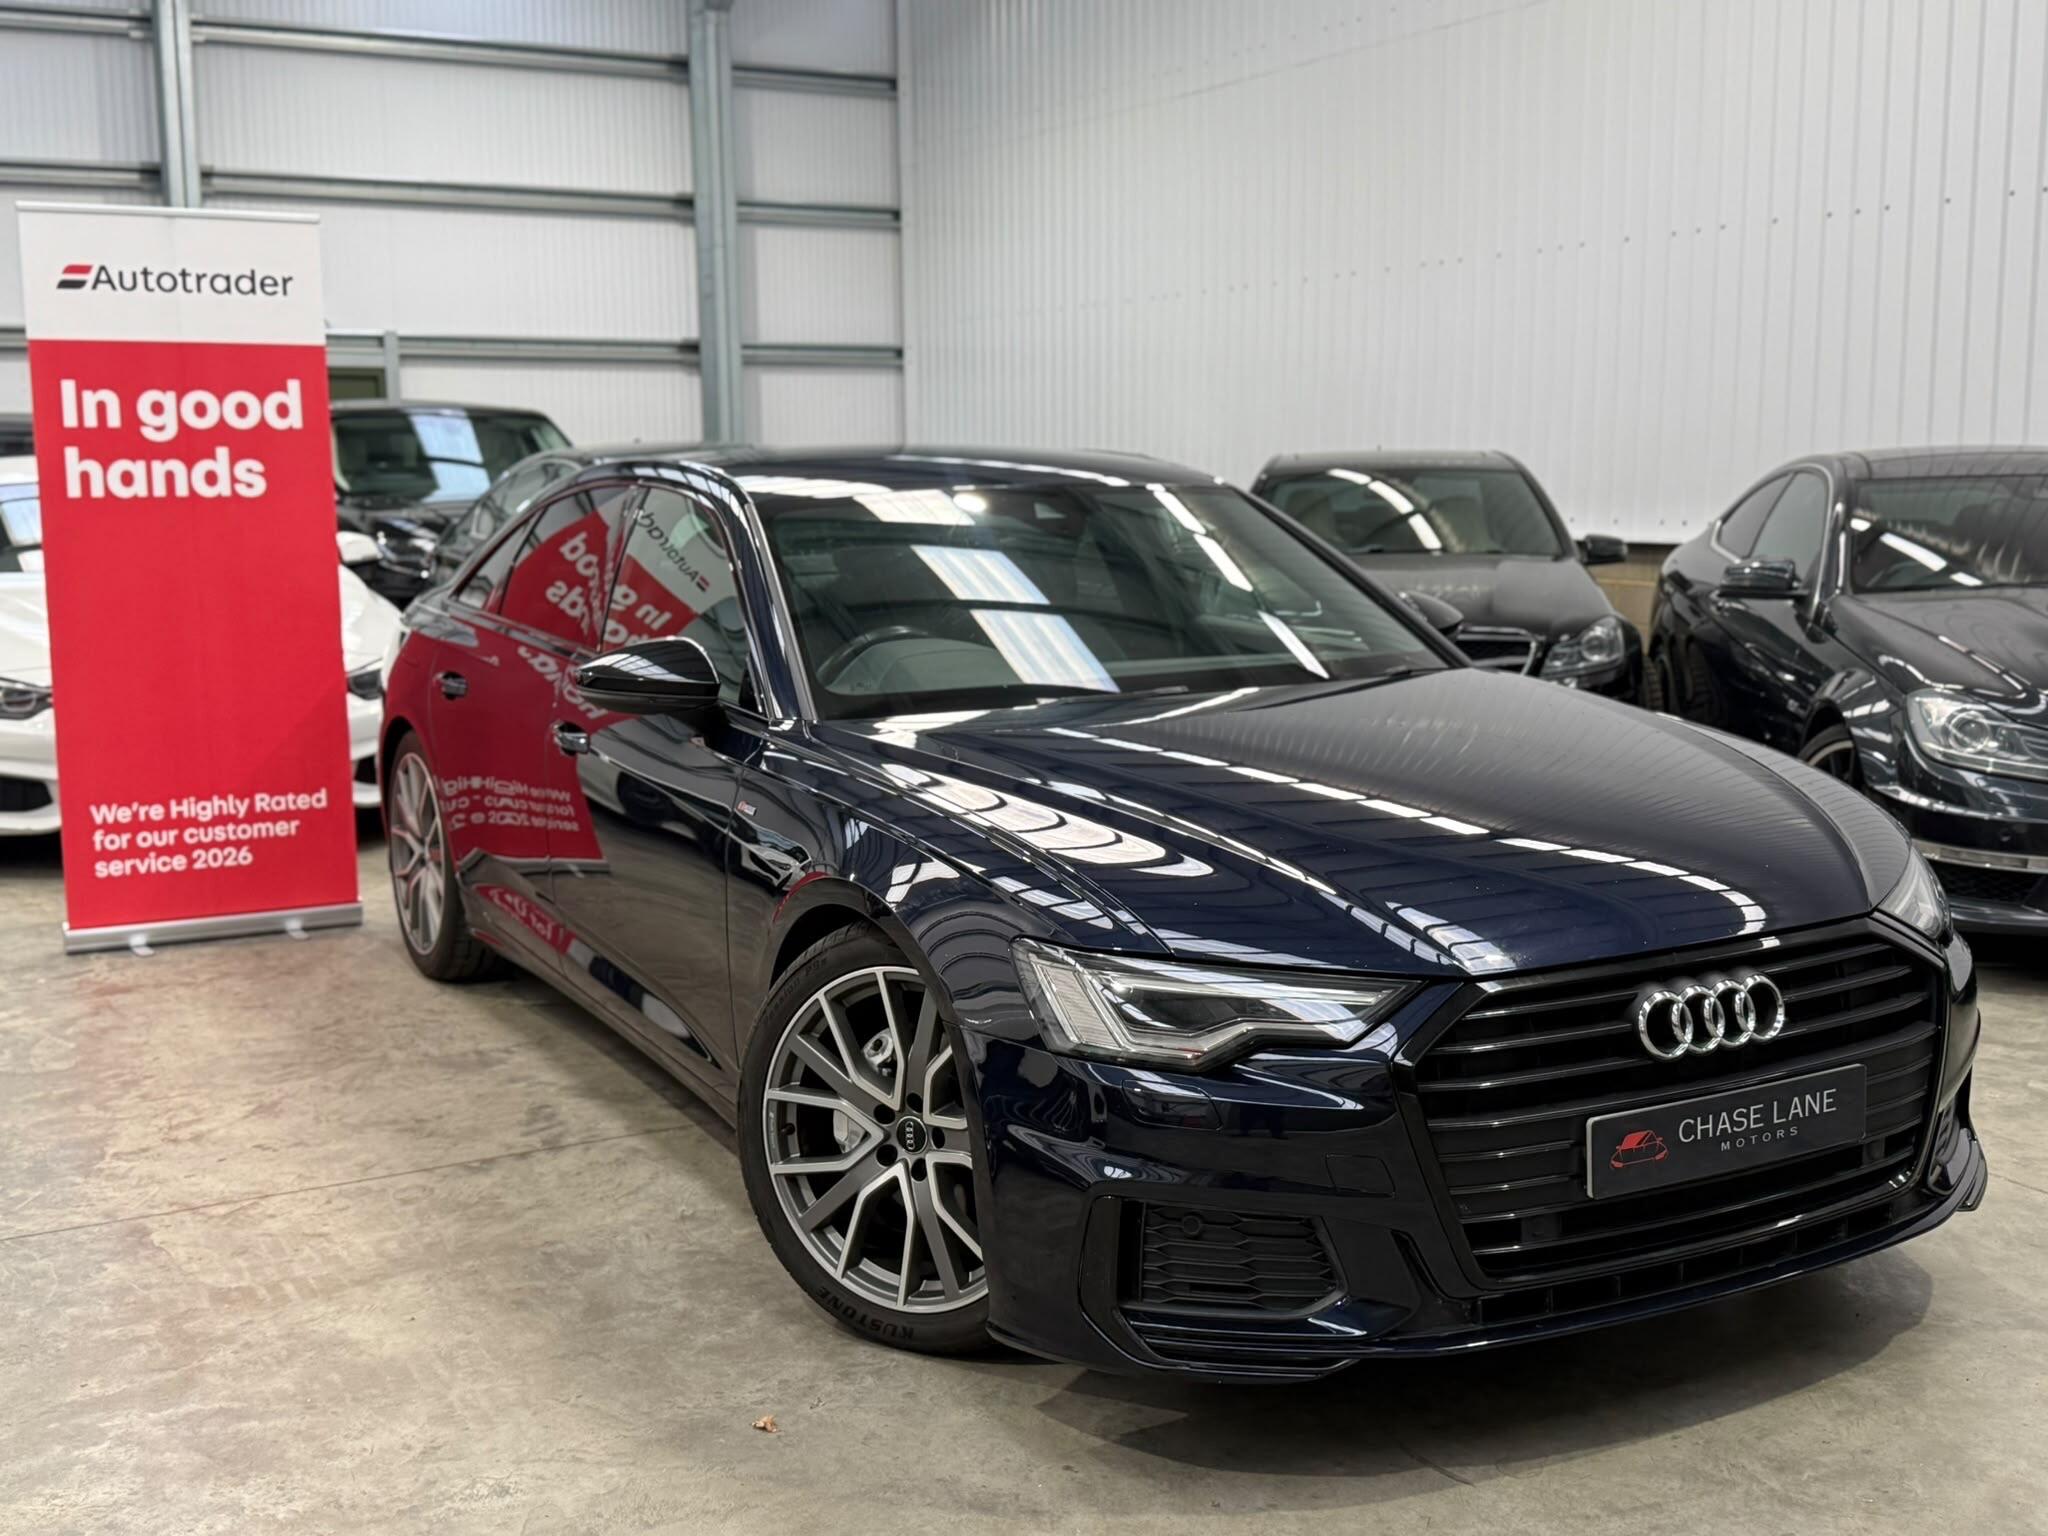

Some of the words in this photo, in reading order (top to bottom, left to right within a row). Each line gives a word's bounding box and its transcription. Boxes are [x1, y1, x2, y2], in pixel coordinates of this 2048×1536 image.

[91, 265, 293, 296] Autotrader
[60, 379, 122, 429] In
[136, 379, 303, 442] good
[64, 446, 267, 498] hands
[90, 802, 165, 824] We're
[170, 794, 250, 822] Highly
[255, 788, 327, 812] Rated
[93, 830, 131, 851] for
[136, 827, 178, 847] our
[183, 819, 299, 844] customer
[94, 853, 187, 878] service
[193, 846, 252, 870] 2026
[1678, 1104, 1764, 1142] CHASE
[1773, 1089, 1837, 1123] LANE
[1721, 1127, 1798, 1151] MOTORS
[816, 1286, 914, 1338] KUSTONE
